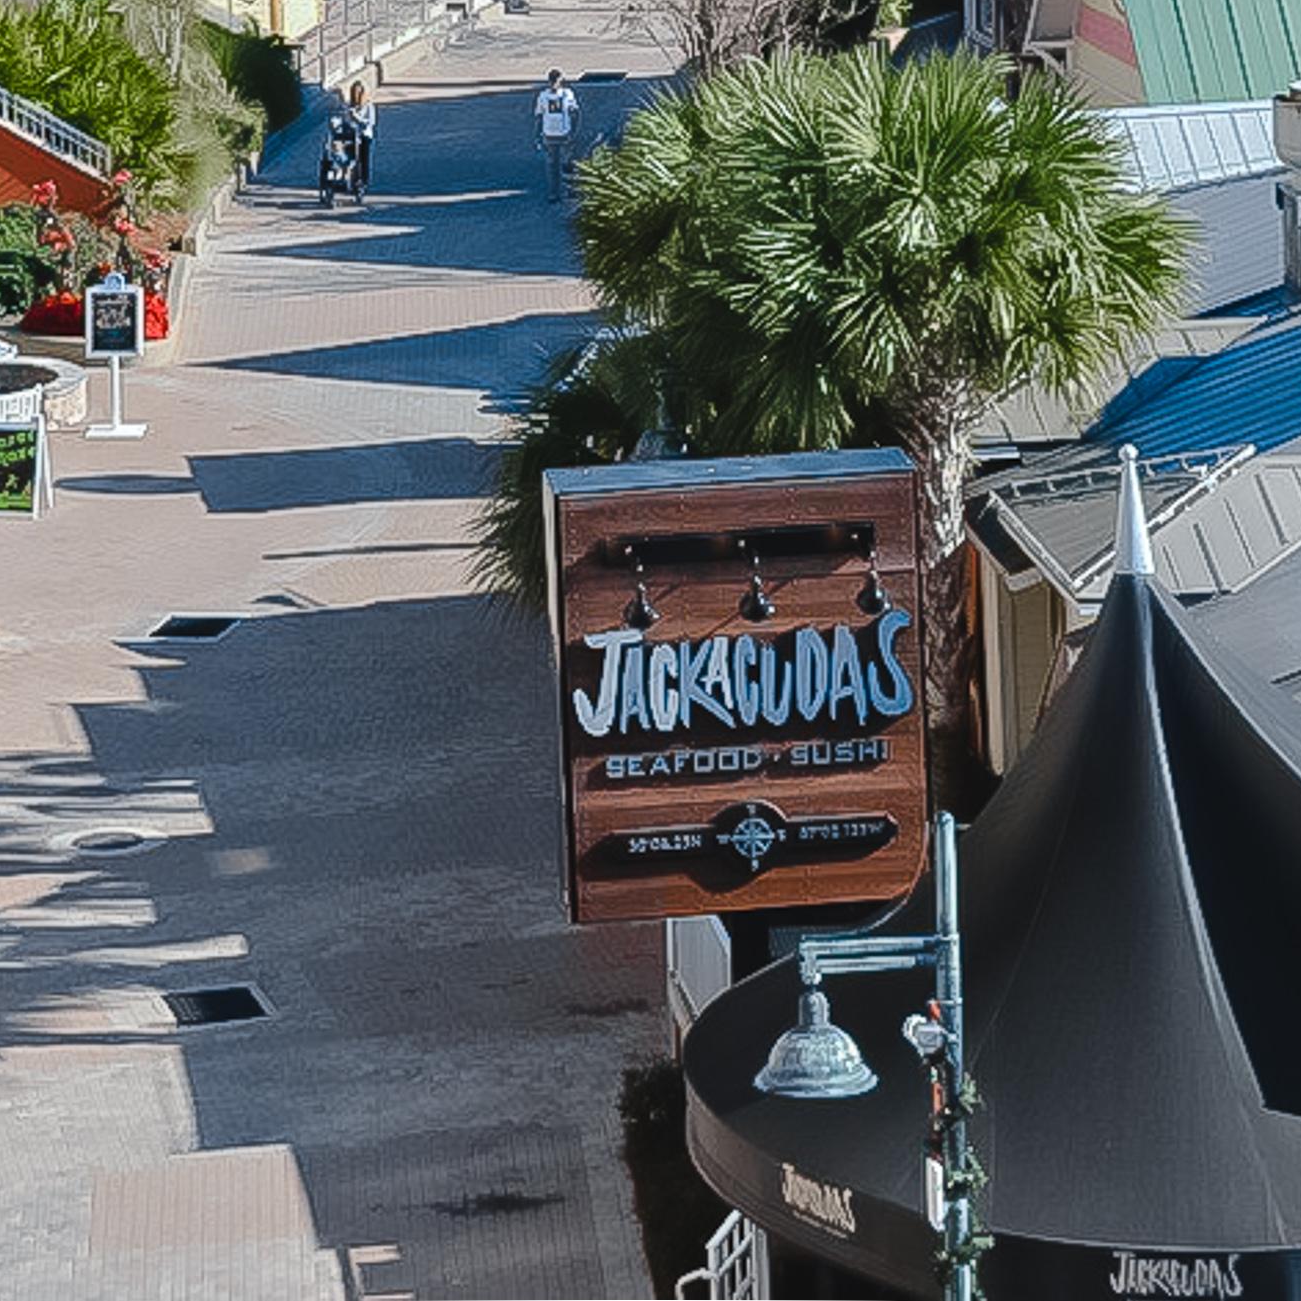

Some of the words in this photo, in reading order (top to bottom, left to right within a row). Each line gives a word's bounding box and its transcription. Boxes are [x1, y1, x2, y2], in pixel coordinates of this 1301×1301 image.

[572, 609, 915, 738] JACKACUDAS
[604, 745, 762, 779] SEAFOOD
[789, 739, 890, 767] SUSHI
